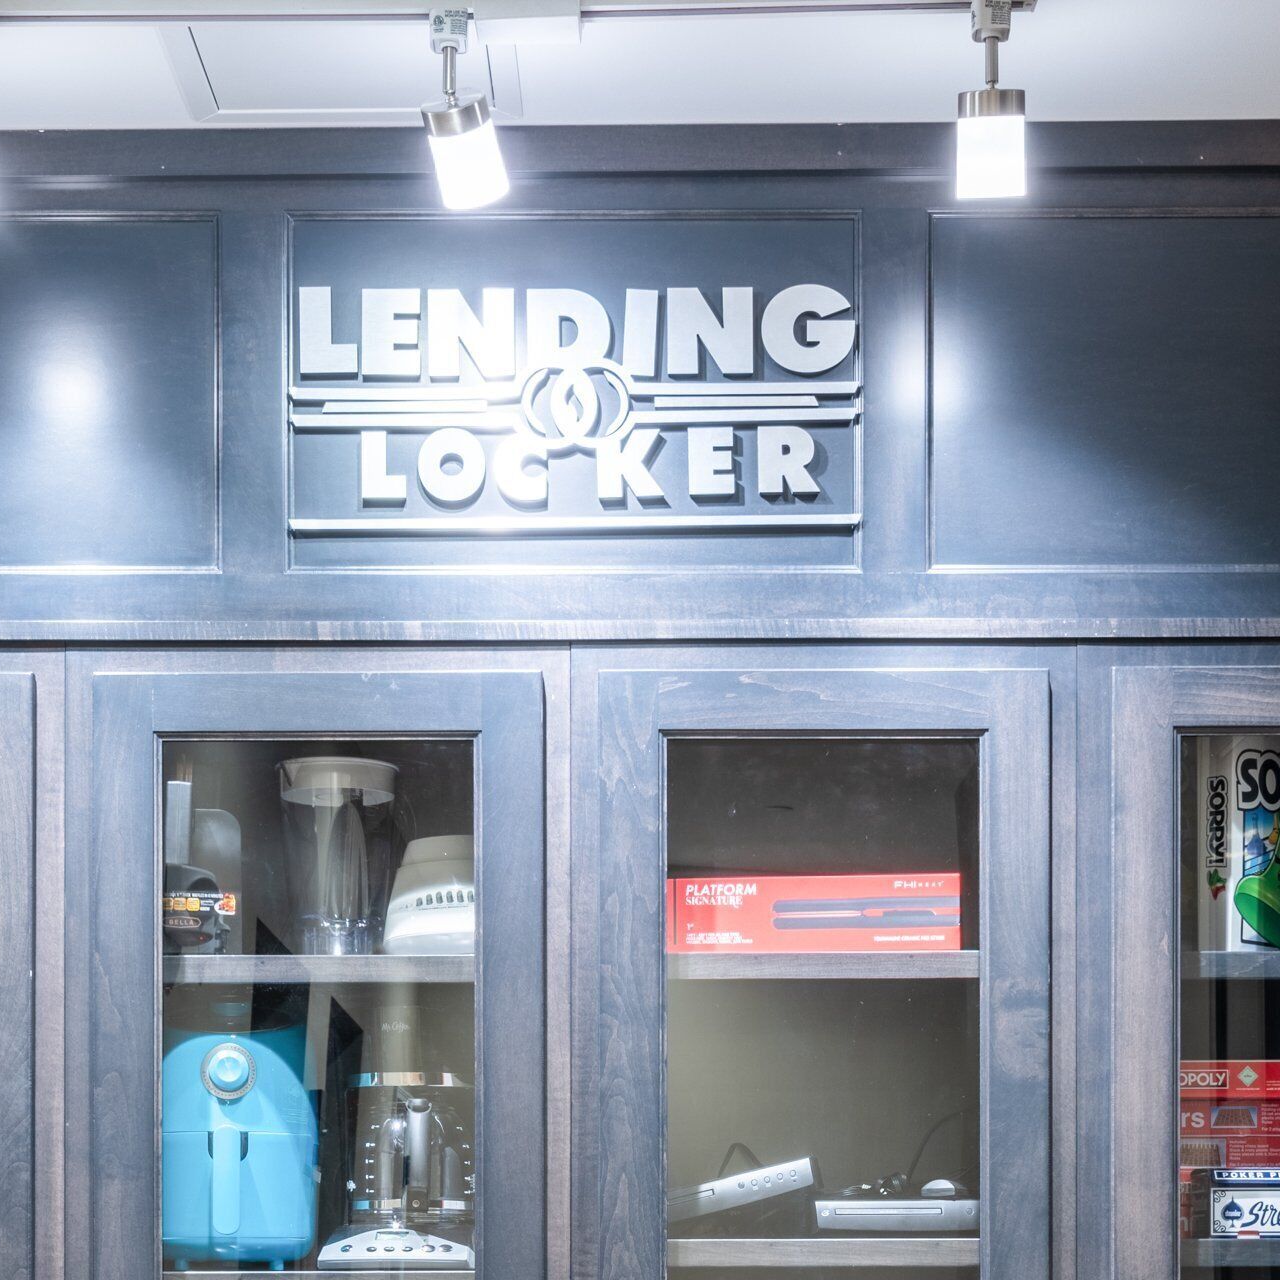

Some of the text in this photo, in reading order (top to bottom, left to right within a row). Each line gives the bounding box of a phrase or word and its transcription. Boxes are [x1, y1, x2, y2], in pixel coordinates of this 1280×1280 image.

[298, 284, 856, 379] LENDING
[360, 427, 822, 508] LOCKER
[1208, 777, 1226, 866] SORRY!
[685, 883, 757, 896] PLATFORM
[685, 895, 744, 909] SIGNATURE
[1222, 1171, 1264, 1179] POKER
